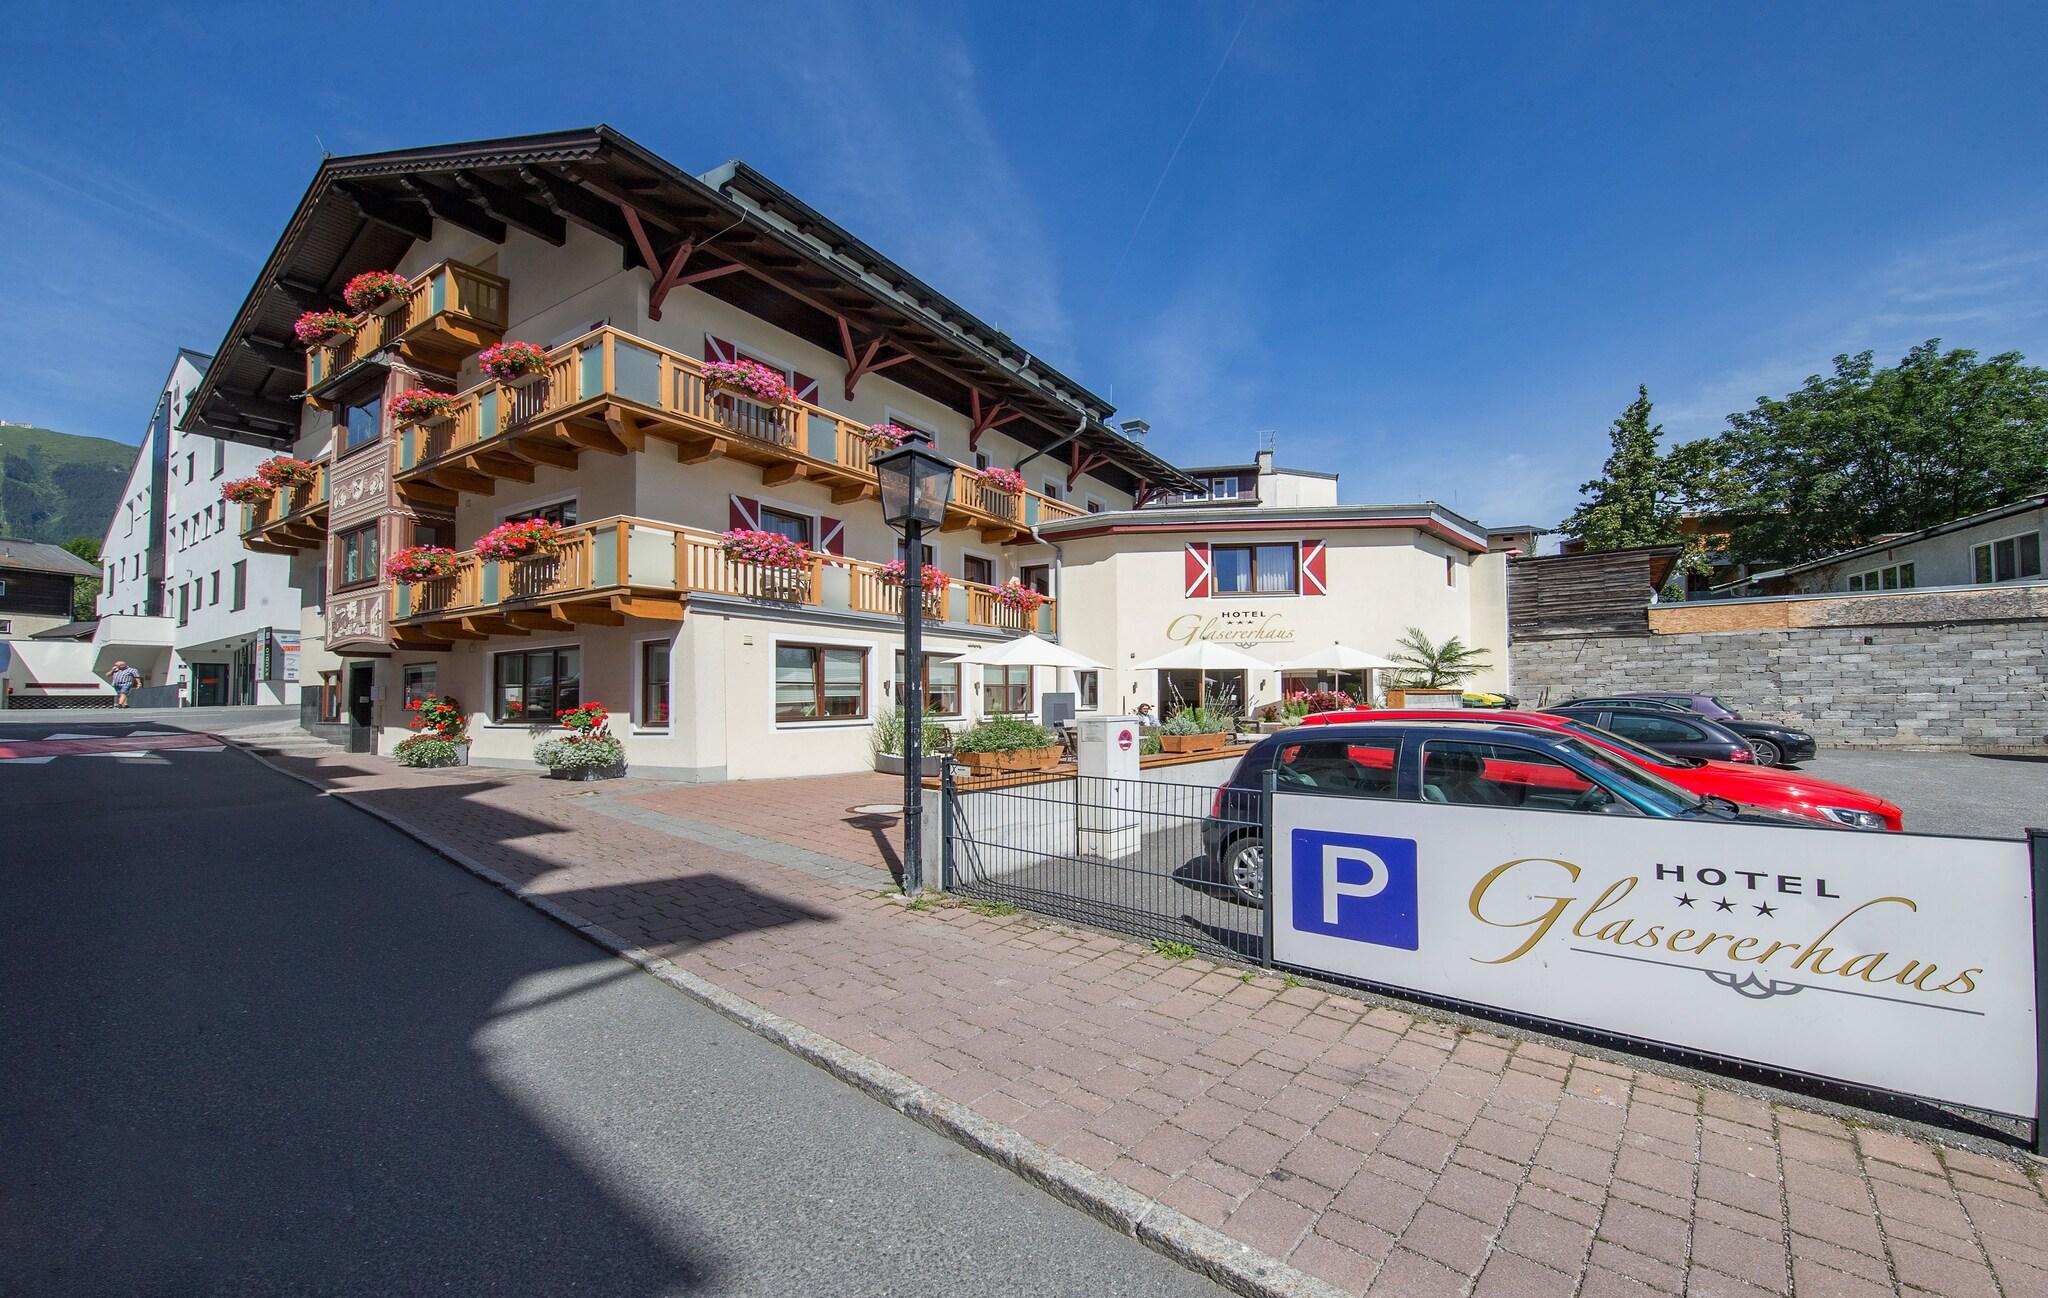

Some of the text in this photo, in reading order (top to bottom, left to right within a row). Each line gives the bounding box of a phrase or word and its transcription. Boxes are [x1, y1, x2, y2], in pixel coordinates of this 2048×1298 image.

[1166, 613, 1296, 646] Glasererhaus
[1221, 610, 1267, 618] HOTEL
[1321, 844, 1390, 926] P
[1655, 862, 1841, 899] HOTEL
[1467, 857, 1985, 996] Glasererhaus
